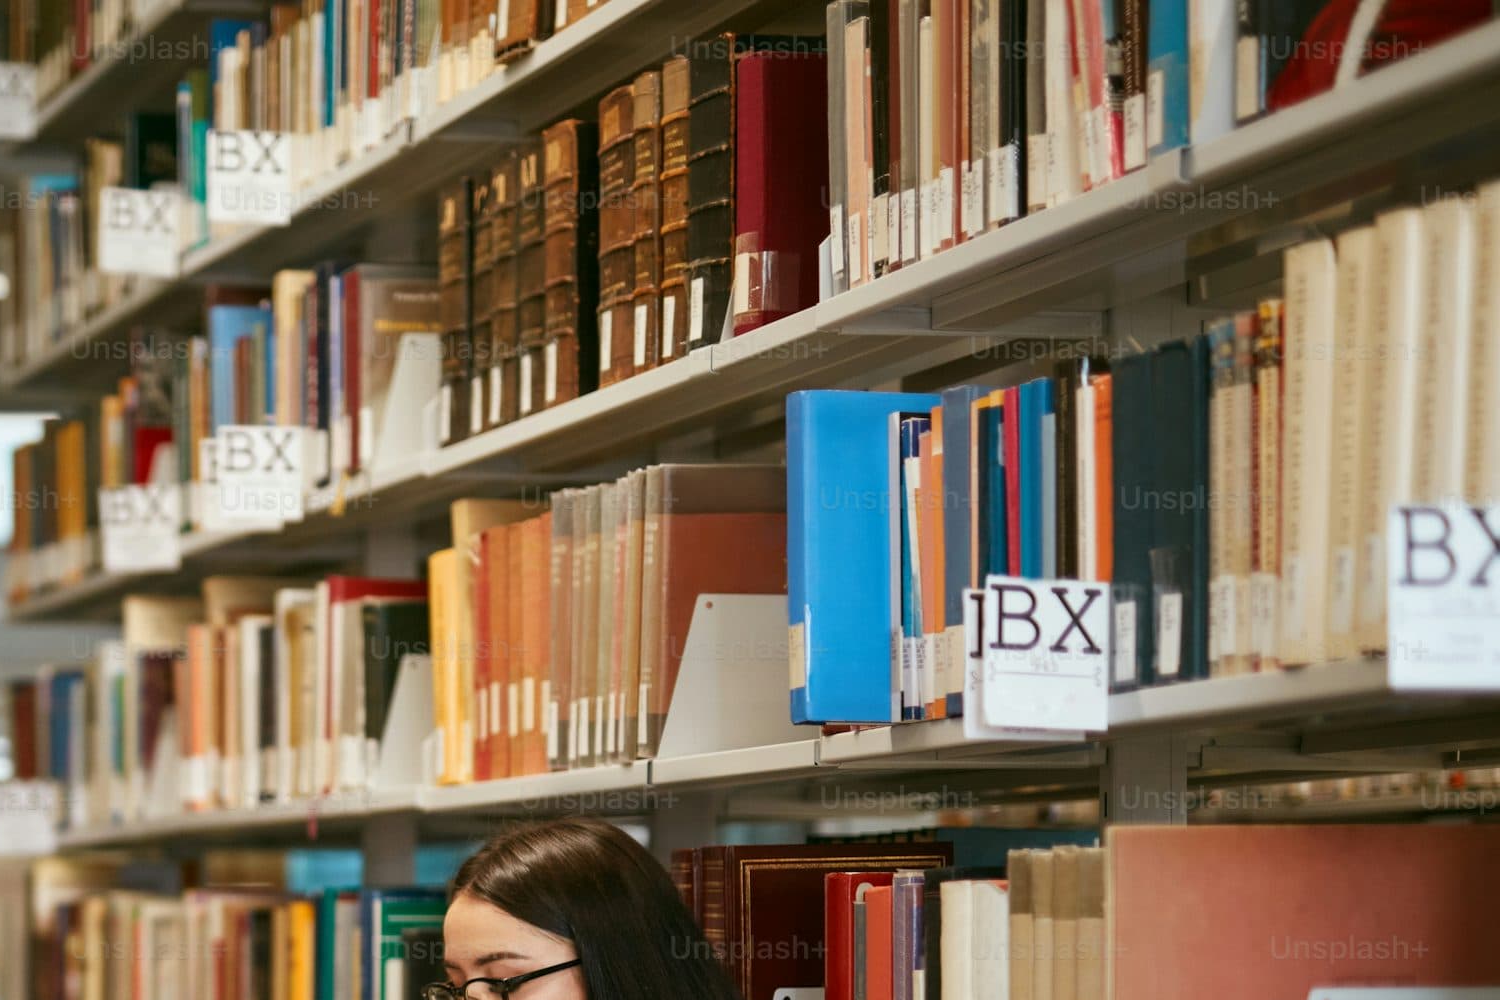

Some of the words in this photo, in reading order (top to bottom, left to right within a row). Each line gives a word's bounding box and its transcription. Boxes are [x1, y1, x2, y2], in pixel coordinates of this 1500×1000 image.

[213, 131, 286, 173] BX
[105, 190, 173, 233] BX
[224, 431, 294, 472] BX
[103, 489, 173, 526] BX
[1397, 506, 1500, 587] BX
[989, 583, 1102, 655] BX
